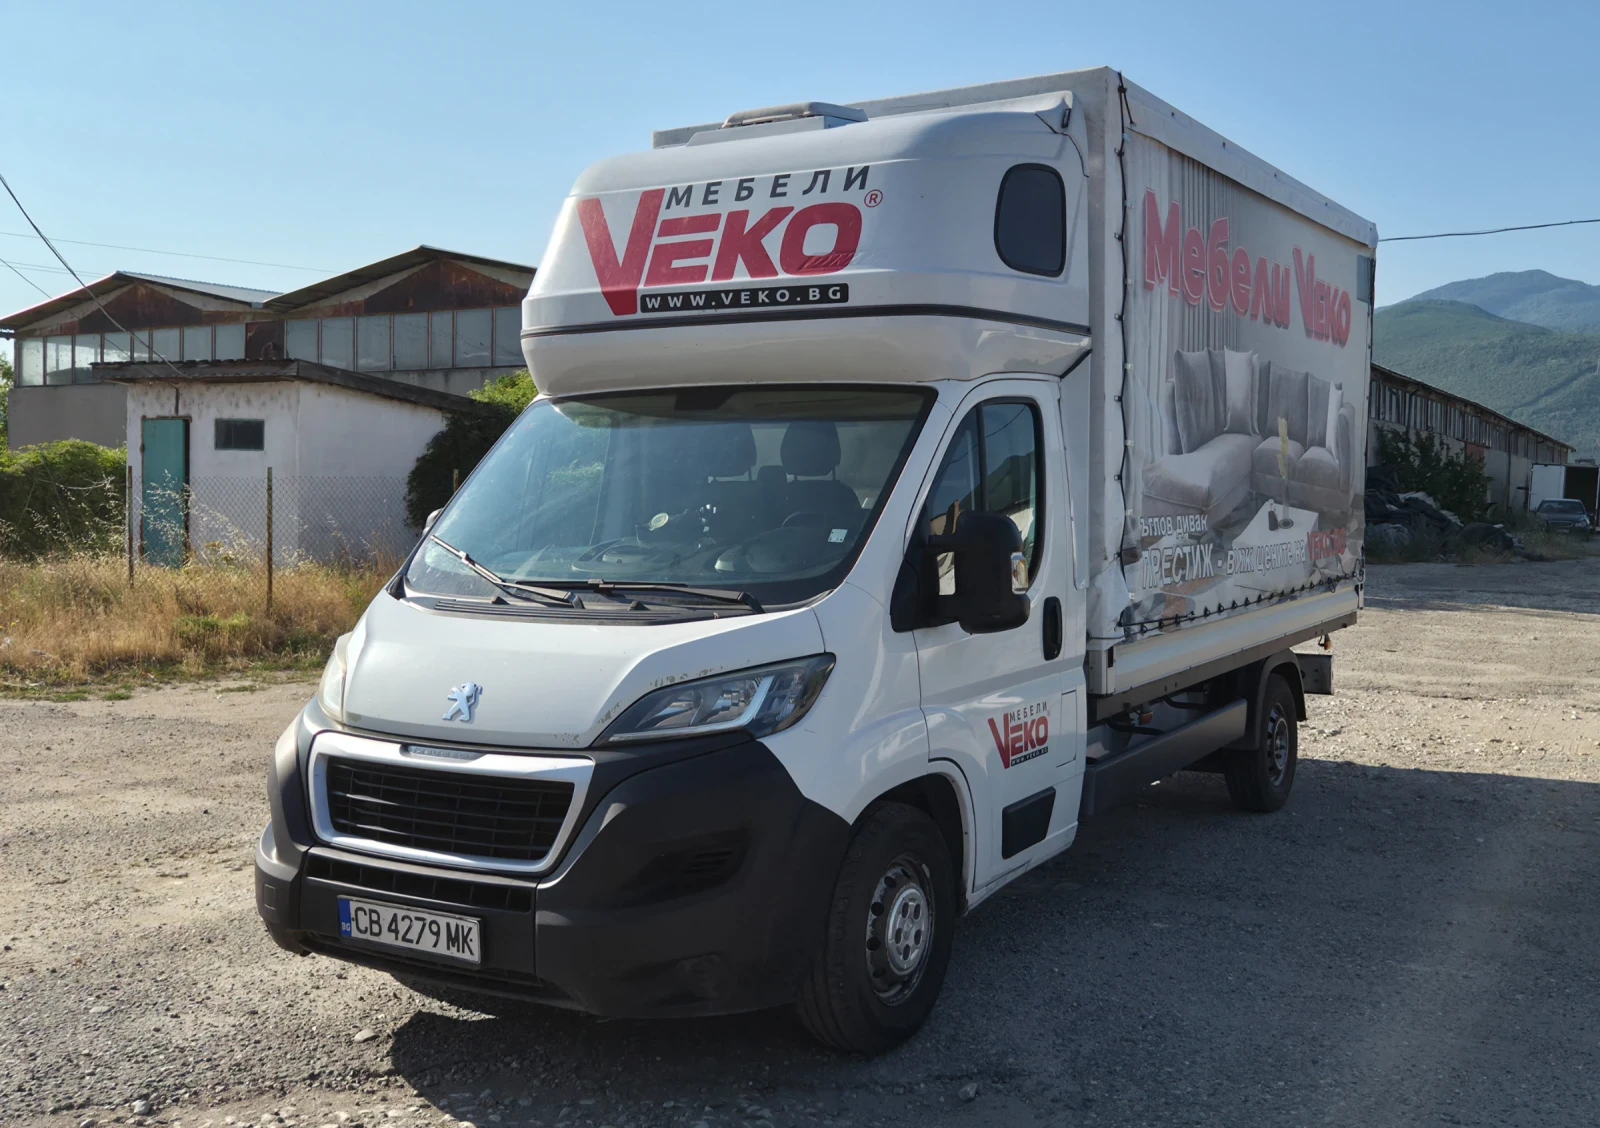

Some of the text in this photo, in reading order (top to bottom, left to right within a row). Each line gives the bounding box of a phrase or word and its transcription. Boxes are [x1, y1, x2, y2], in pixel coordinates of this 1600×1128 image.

[664, 165, 871, 210] МЕБЕЛИ
[576, 187, 863, 316] VEKO
[1143, 186, 1292, 330] Мебели
[644, 285, 842, 310] WWW.VEKO.BG
[1141, 542, 1215, 590] ПРЕСТИЖ
[1009, 700, 1047, 724] МЕБЕЛИ
[987, 712, 1049, 770] VEKO
